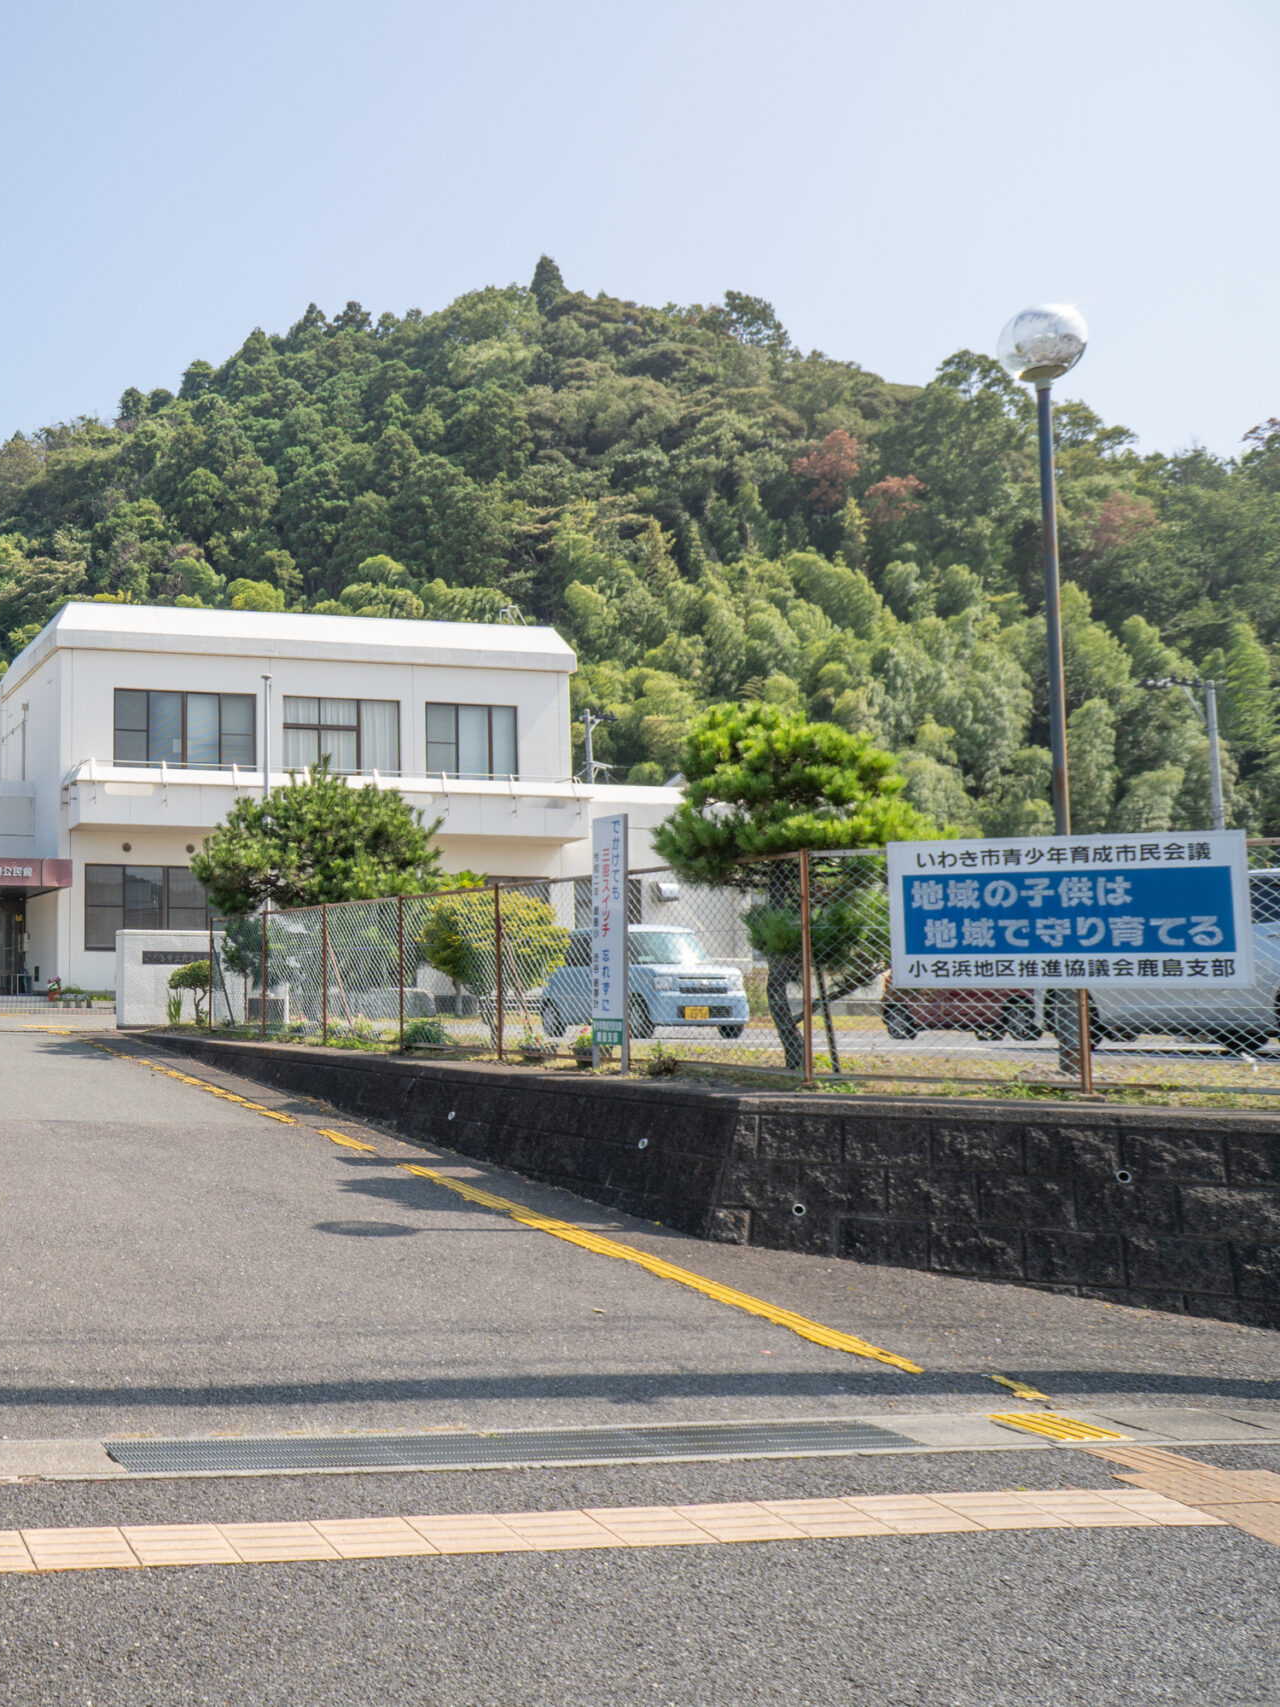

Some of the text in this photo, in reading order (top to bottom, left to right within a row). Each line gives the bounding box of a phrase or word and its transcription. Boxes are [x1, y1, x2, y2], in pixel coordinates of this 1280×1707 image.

[611, 820, 621, 900] でかけても
[916, 842, 1212, 869] いわき市青少年育成市民会議
[911, 875, 1133, 911] 地域の子供は
[924, 915, 1224, 949] 地域で守り育てる
[908, 958, 1235, 979] 小名浜地区推進協議会鹿島支部
